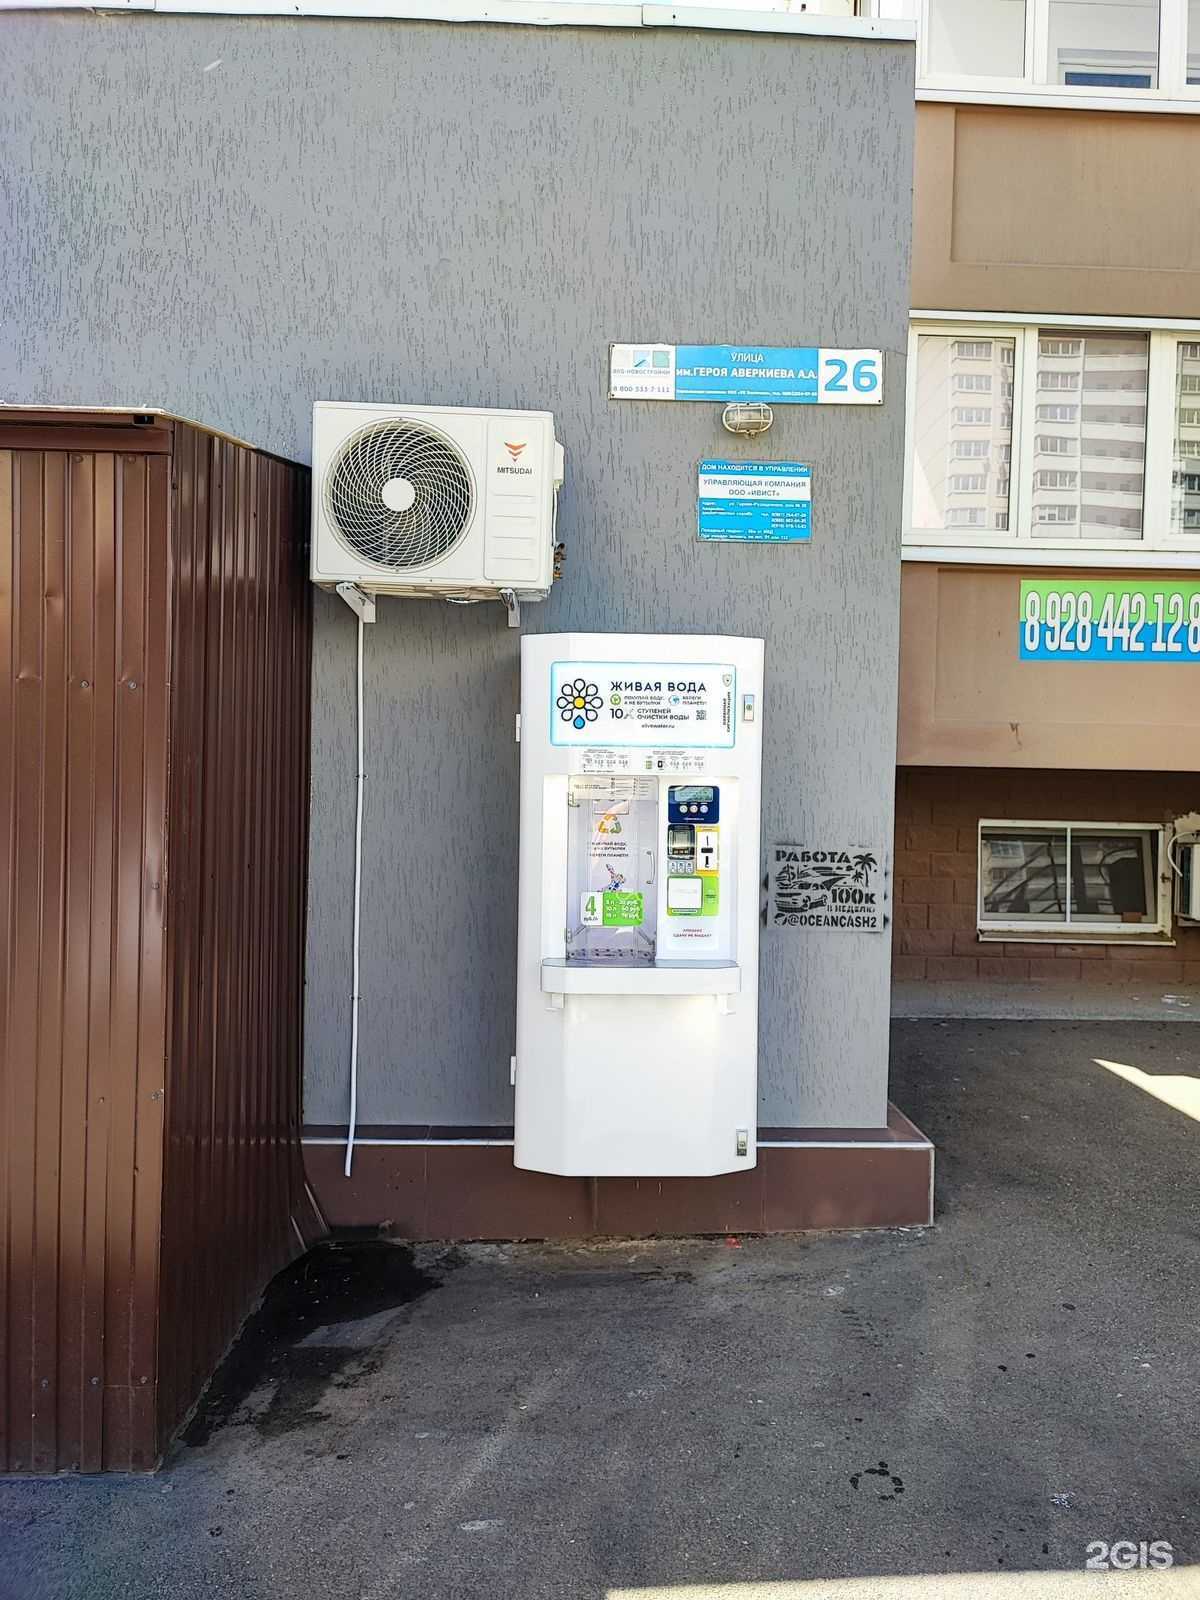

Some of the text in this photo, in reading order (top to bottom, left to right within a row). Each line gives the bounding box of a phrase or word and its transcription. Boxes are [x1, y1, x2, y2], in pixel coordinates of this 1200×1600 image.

[730, 351, 764, 363] УЛИЦА
[731, 368, 795, 378] АВЕРКИЕВА
[797, 369, 818, 379] А.А.
[824, 358, 878, 393] 26
[496, 466, 533, 475] MITSUDAI
[702, 463, 717, 471] ДОМ
[718, 464, 758, 472] НАХОДИТСЯ
[703, 479, 807, 488] УПРАВЛЯЮЩАЯ КОМПАНИЯ
[610, 681, 707, 693] ЖИВАЯ ВОДА
[609, 708, 624, 720] 10
[775, 849, 852, 864] РАБОТА
[585, 895, 597, 916] 4
[834, 905, 876, 914] НЕДЕЛЮ
[788, 914, 877, 928] @OCEANCASH2
